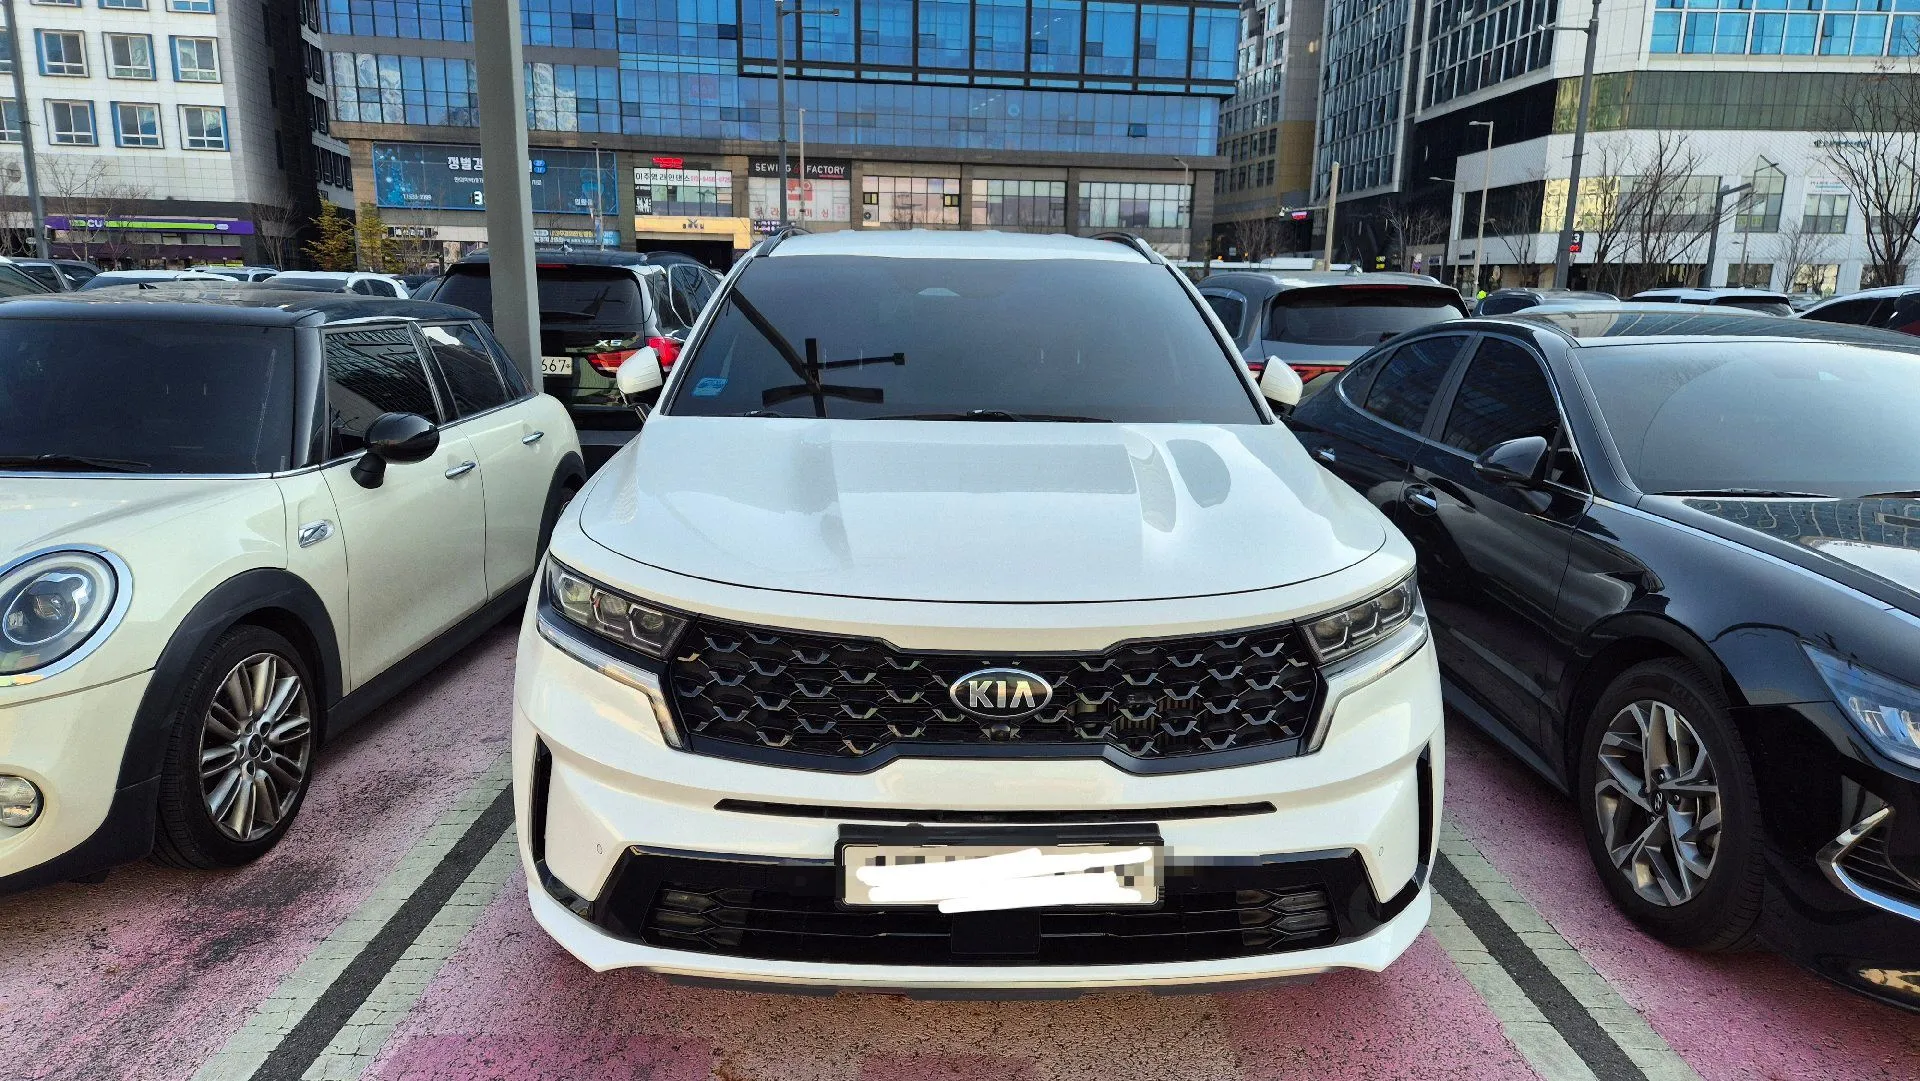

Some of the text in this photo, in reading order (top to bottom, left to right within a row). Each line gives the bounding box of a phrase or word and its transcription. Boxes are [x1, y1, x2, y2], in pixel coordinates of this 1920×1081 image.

[755, 163, 845, 174] SEWIG FACTORY
[87, 219, 103, 228] CU
[595, 339, 622, 347] X5
[968, 680, 1036, 708] KIA
